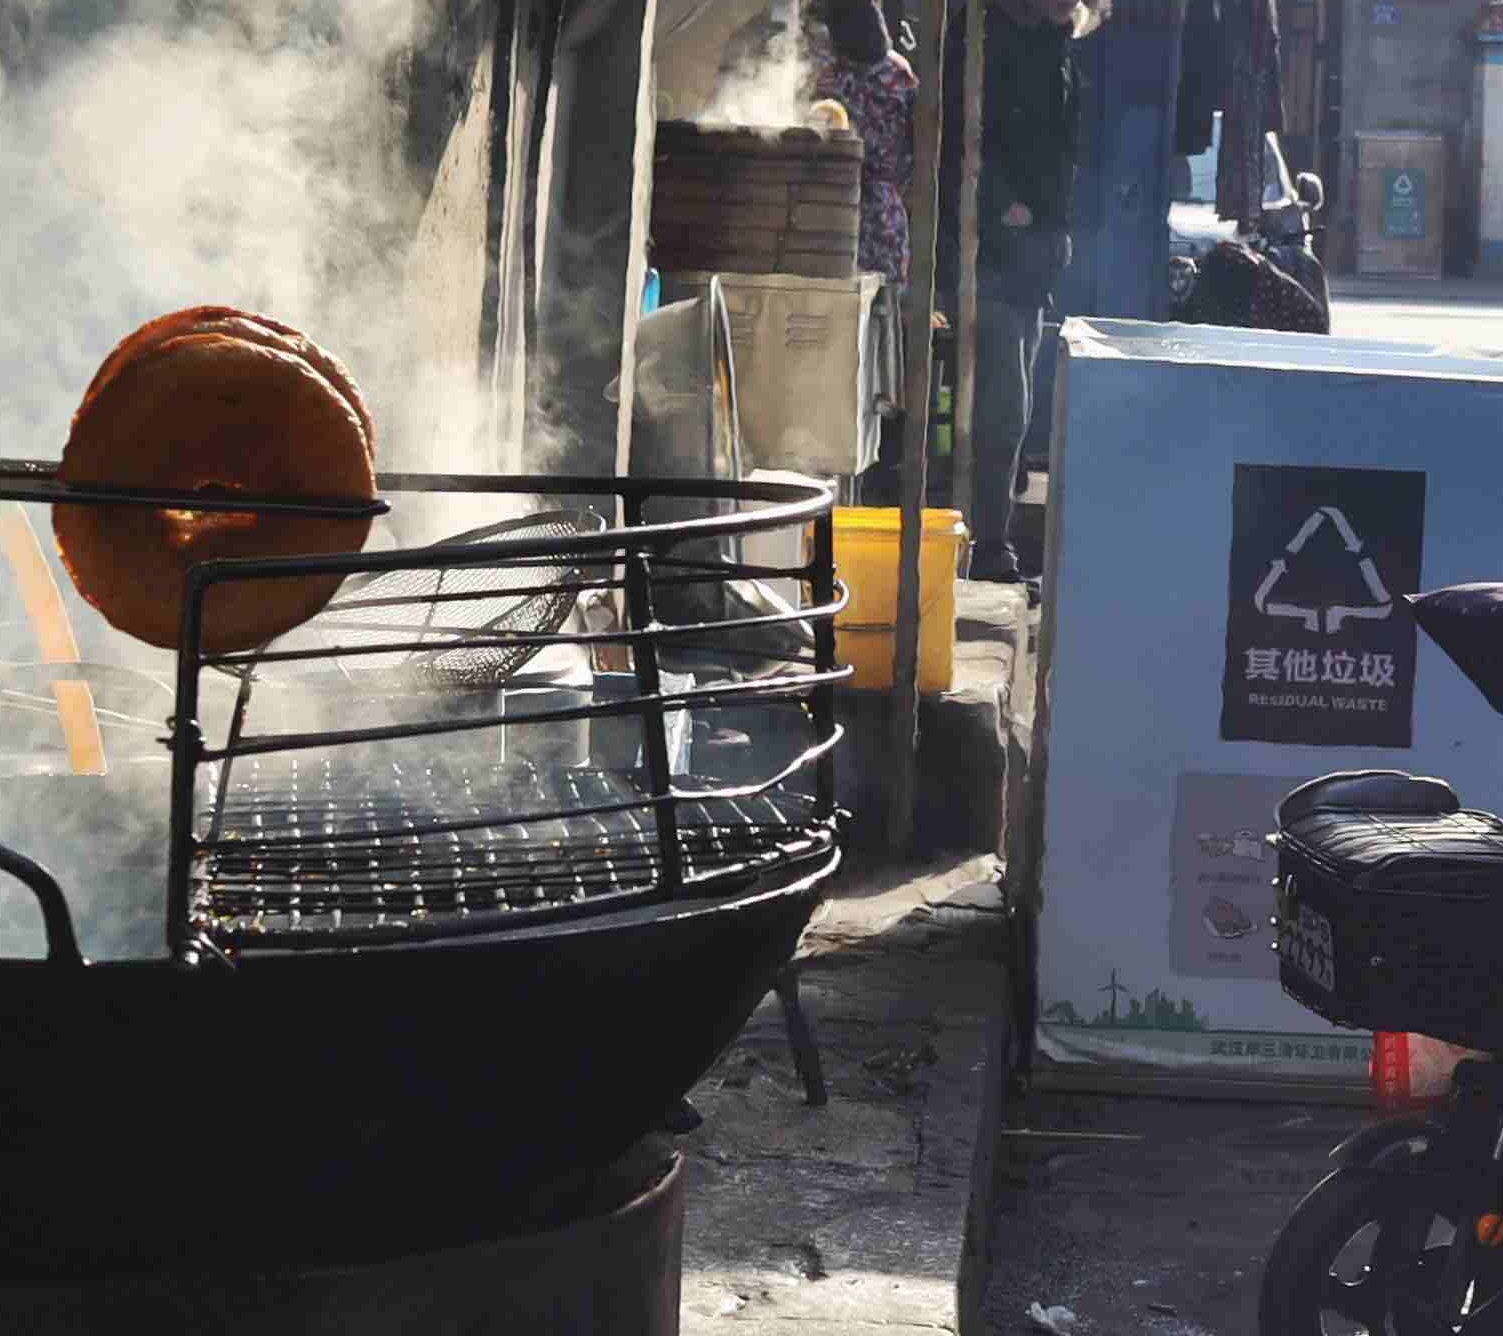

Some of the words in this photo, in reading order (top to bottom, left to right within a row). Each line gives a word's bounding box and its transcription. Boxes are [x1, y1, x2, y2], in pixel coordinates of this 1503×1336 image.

[1243, 647, 1395, 687] 其他垃圾
[1248, 692, 1328, 708] RESIDUAL
[1331, 695, 1387, 712] WASTE
